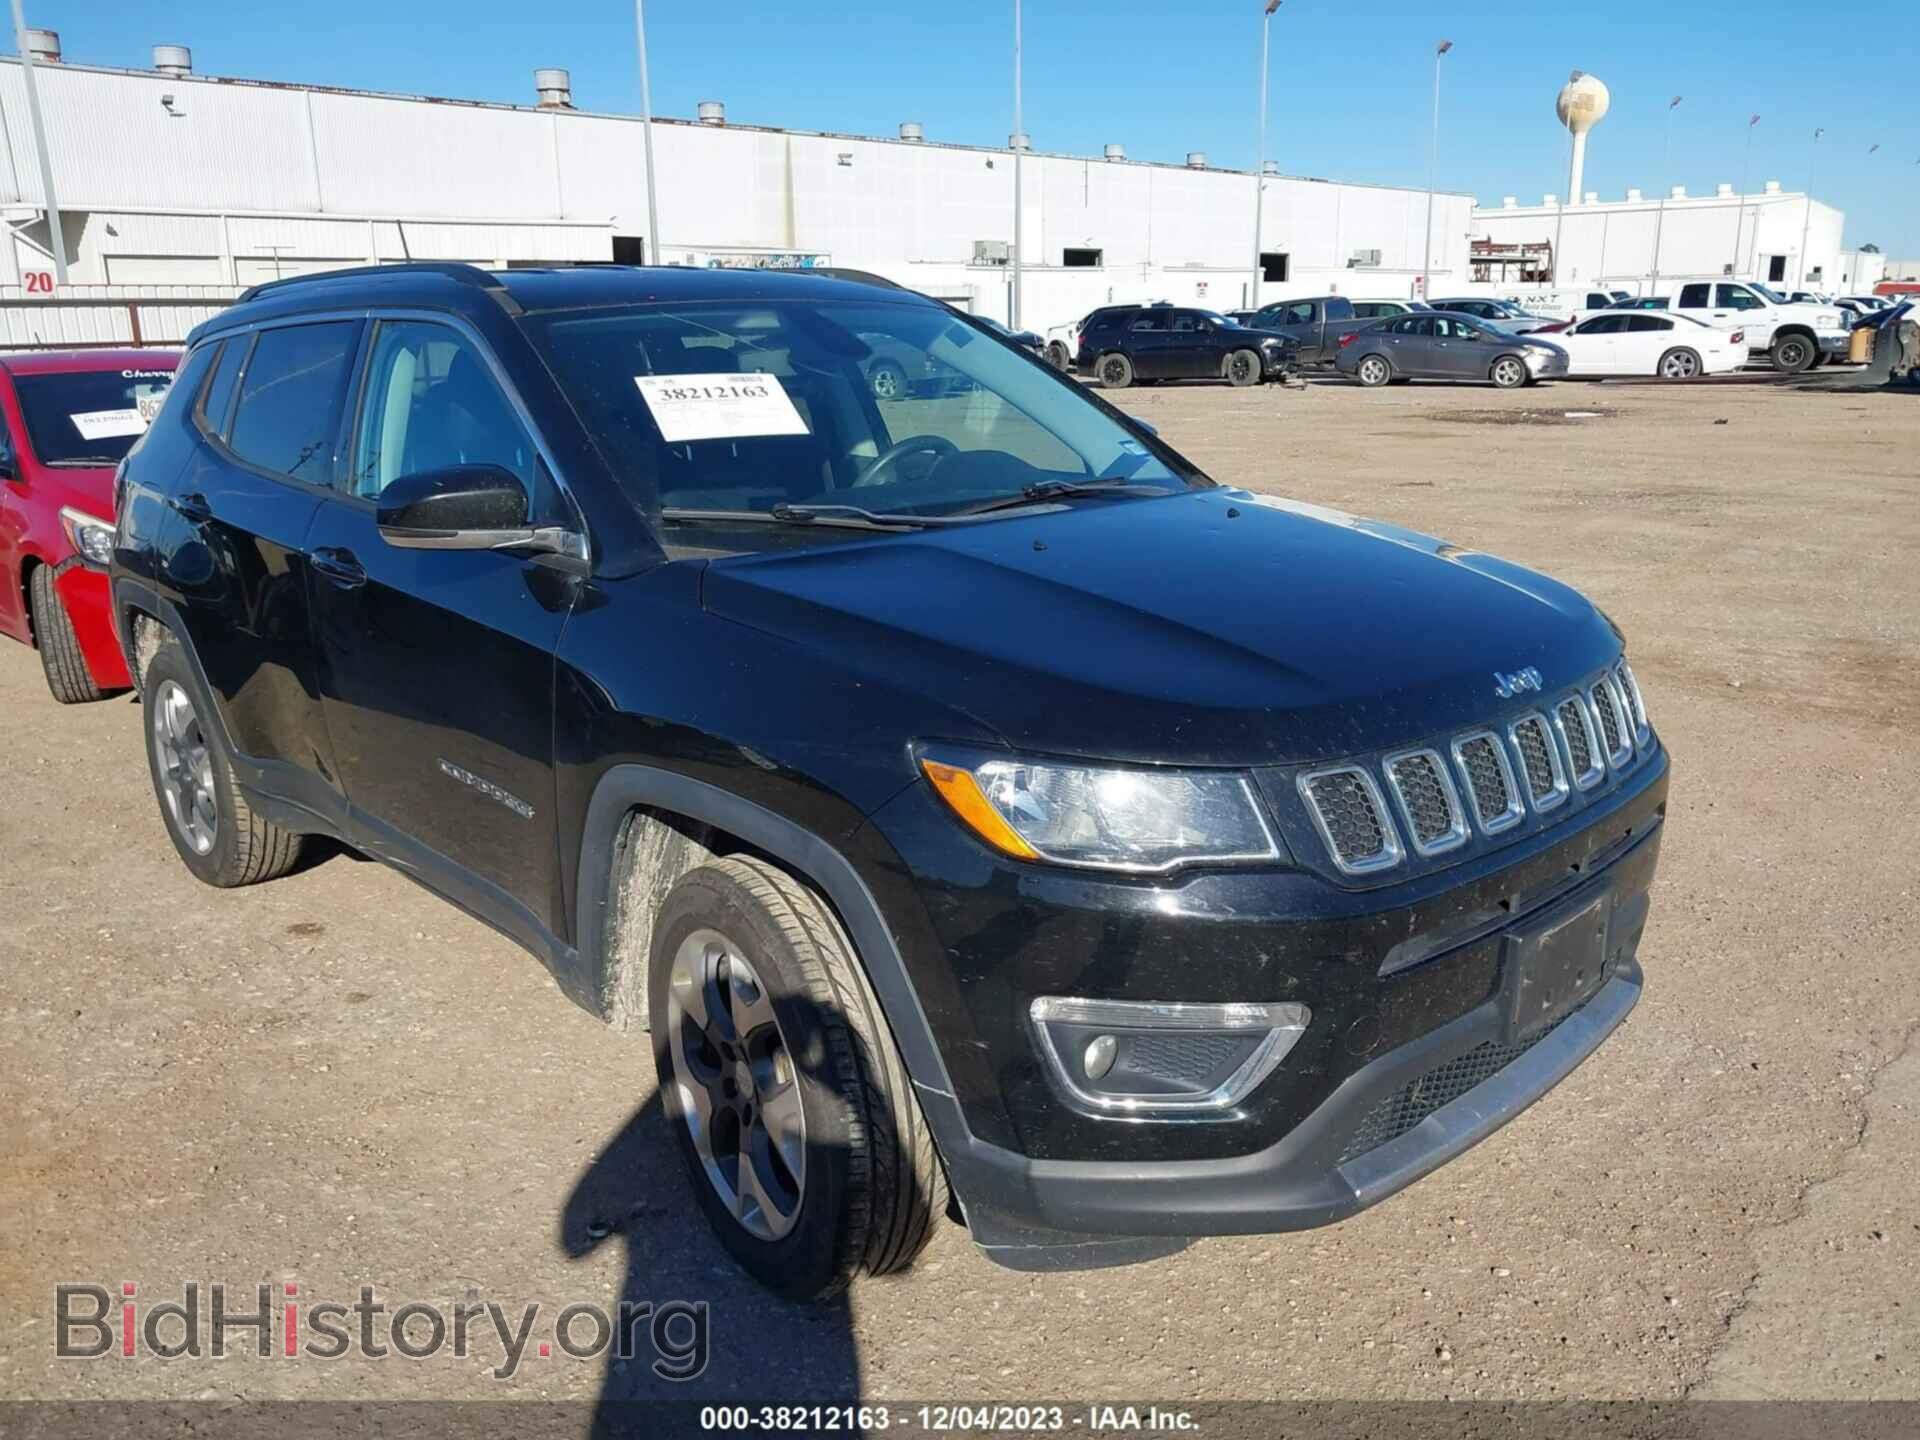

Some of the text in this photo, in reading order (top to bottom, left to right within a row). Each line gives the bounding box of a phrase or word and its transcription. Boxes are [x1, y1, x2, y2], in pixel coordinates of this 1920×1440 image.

[25, 271, 53, 293] 20
[658, 384, 769, 402] 38212163
[1493, 666, 1543, 699] Jeep
